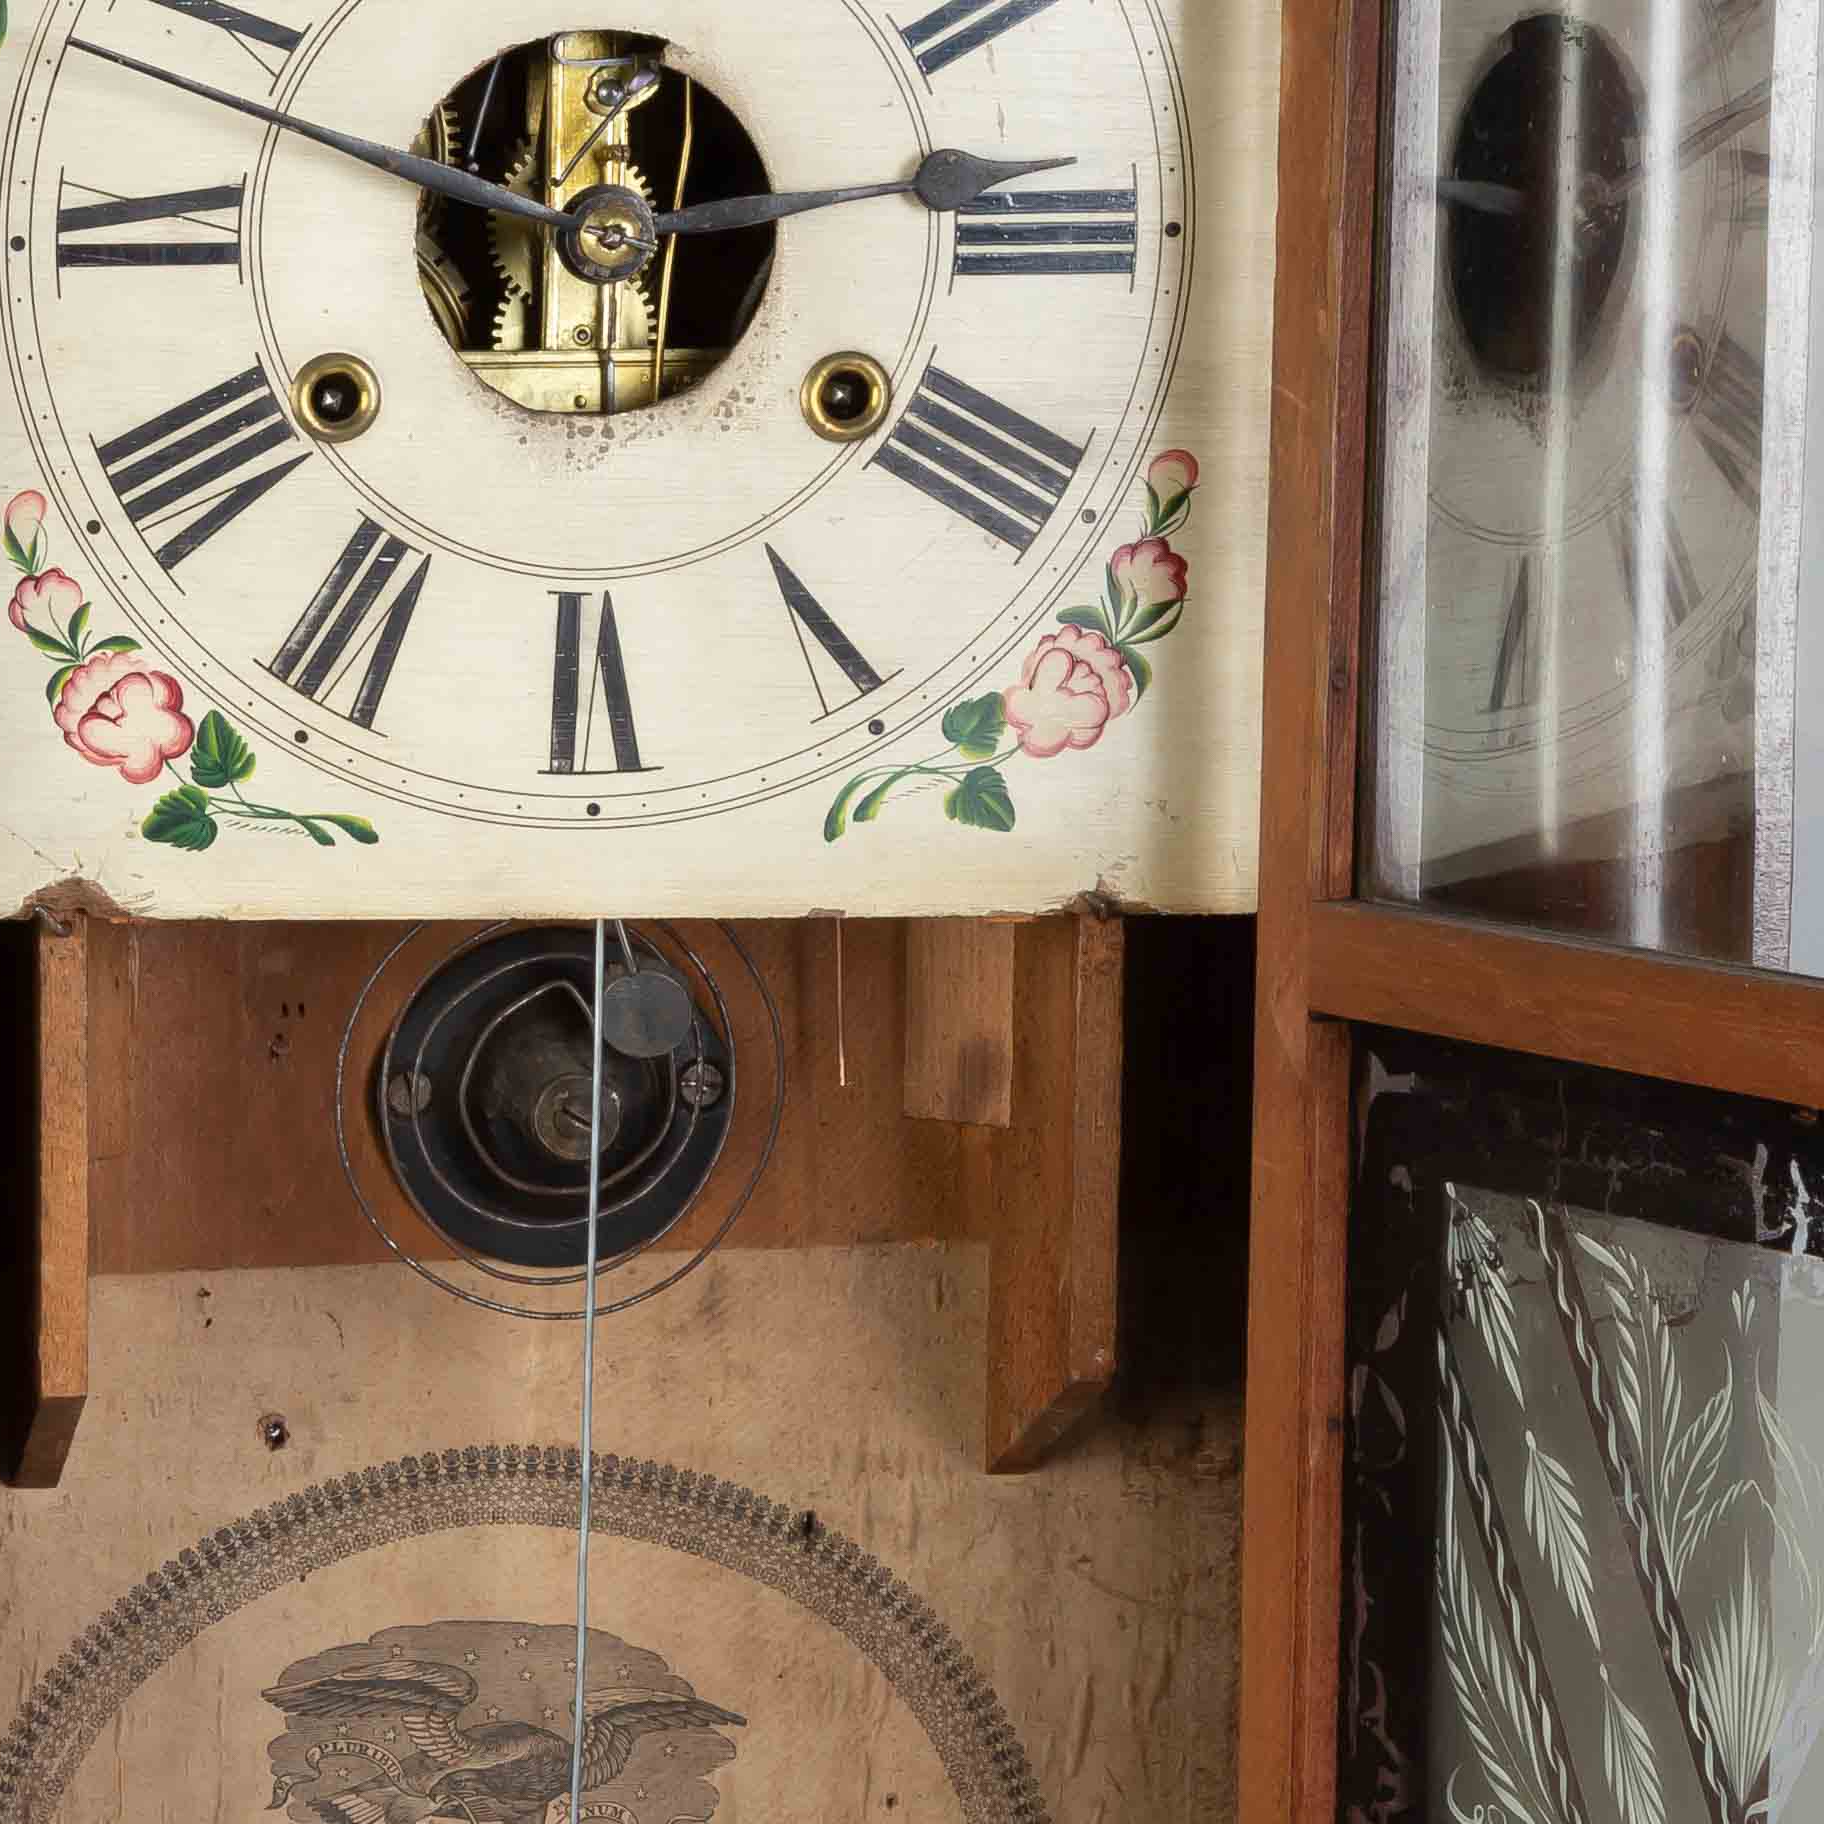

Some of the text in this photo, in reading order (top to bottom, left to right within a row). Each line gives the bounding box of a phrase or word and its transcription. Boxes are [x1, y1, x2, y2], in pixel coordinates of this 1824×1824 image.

[56, 165, 248, 300] IX
[948, 161, 1138, 295] III
[89, 352, 314, 596] VIII
[862, 344, 1096, 566] IIII
[253, 508, 432, 739] VII
[536, 590, 663, 776] VI
[764, 542, 904, 724] V
